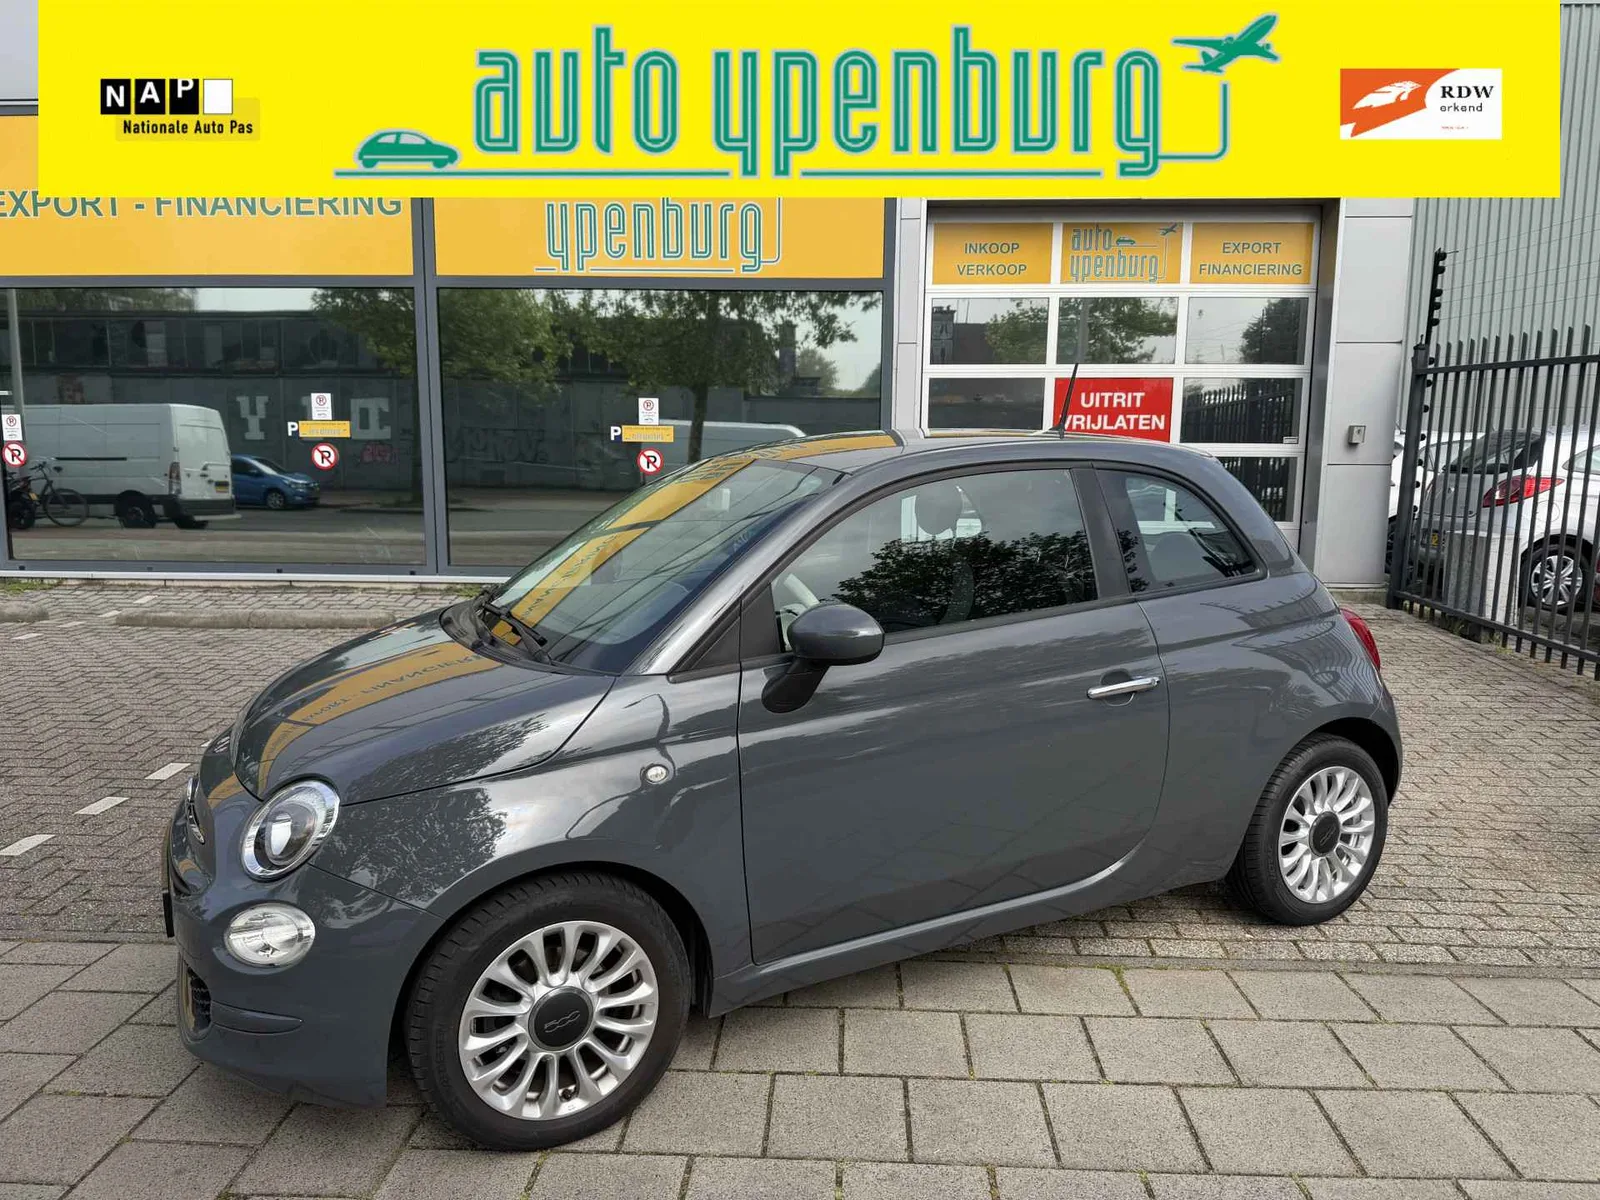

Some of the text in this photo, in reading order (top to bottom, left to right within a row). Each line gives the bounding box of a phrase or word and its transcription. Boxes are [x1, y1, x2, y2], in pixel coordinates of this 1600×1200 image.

[156, 197, 401, 216] FINANCIERING
[545, 197, 762, 272] ypenburg
[1072, 223, 1113, 251] auto
[964, 242, 1020, 255] INKOOP
[1222, 242, 1281, 255] EXPORT
[957, 263, 1027, 276] VERKOOP
[1071, 249, 1159, 283] ypenburg
[1199, 263, 1303, 276] FINANCIERING
[1080, 392, 1145, 408] UITRIT
[287, 421, 299, 437] P
[610, 426, 622, 441] P
